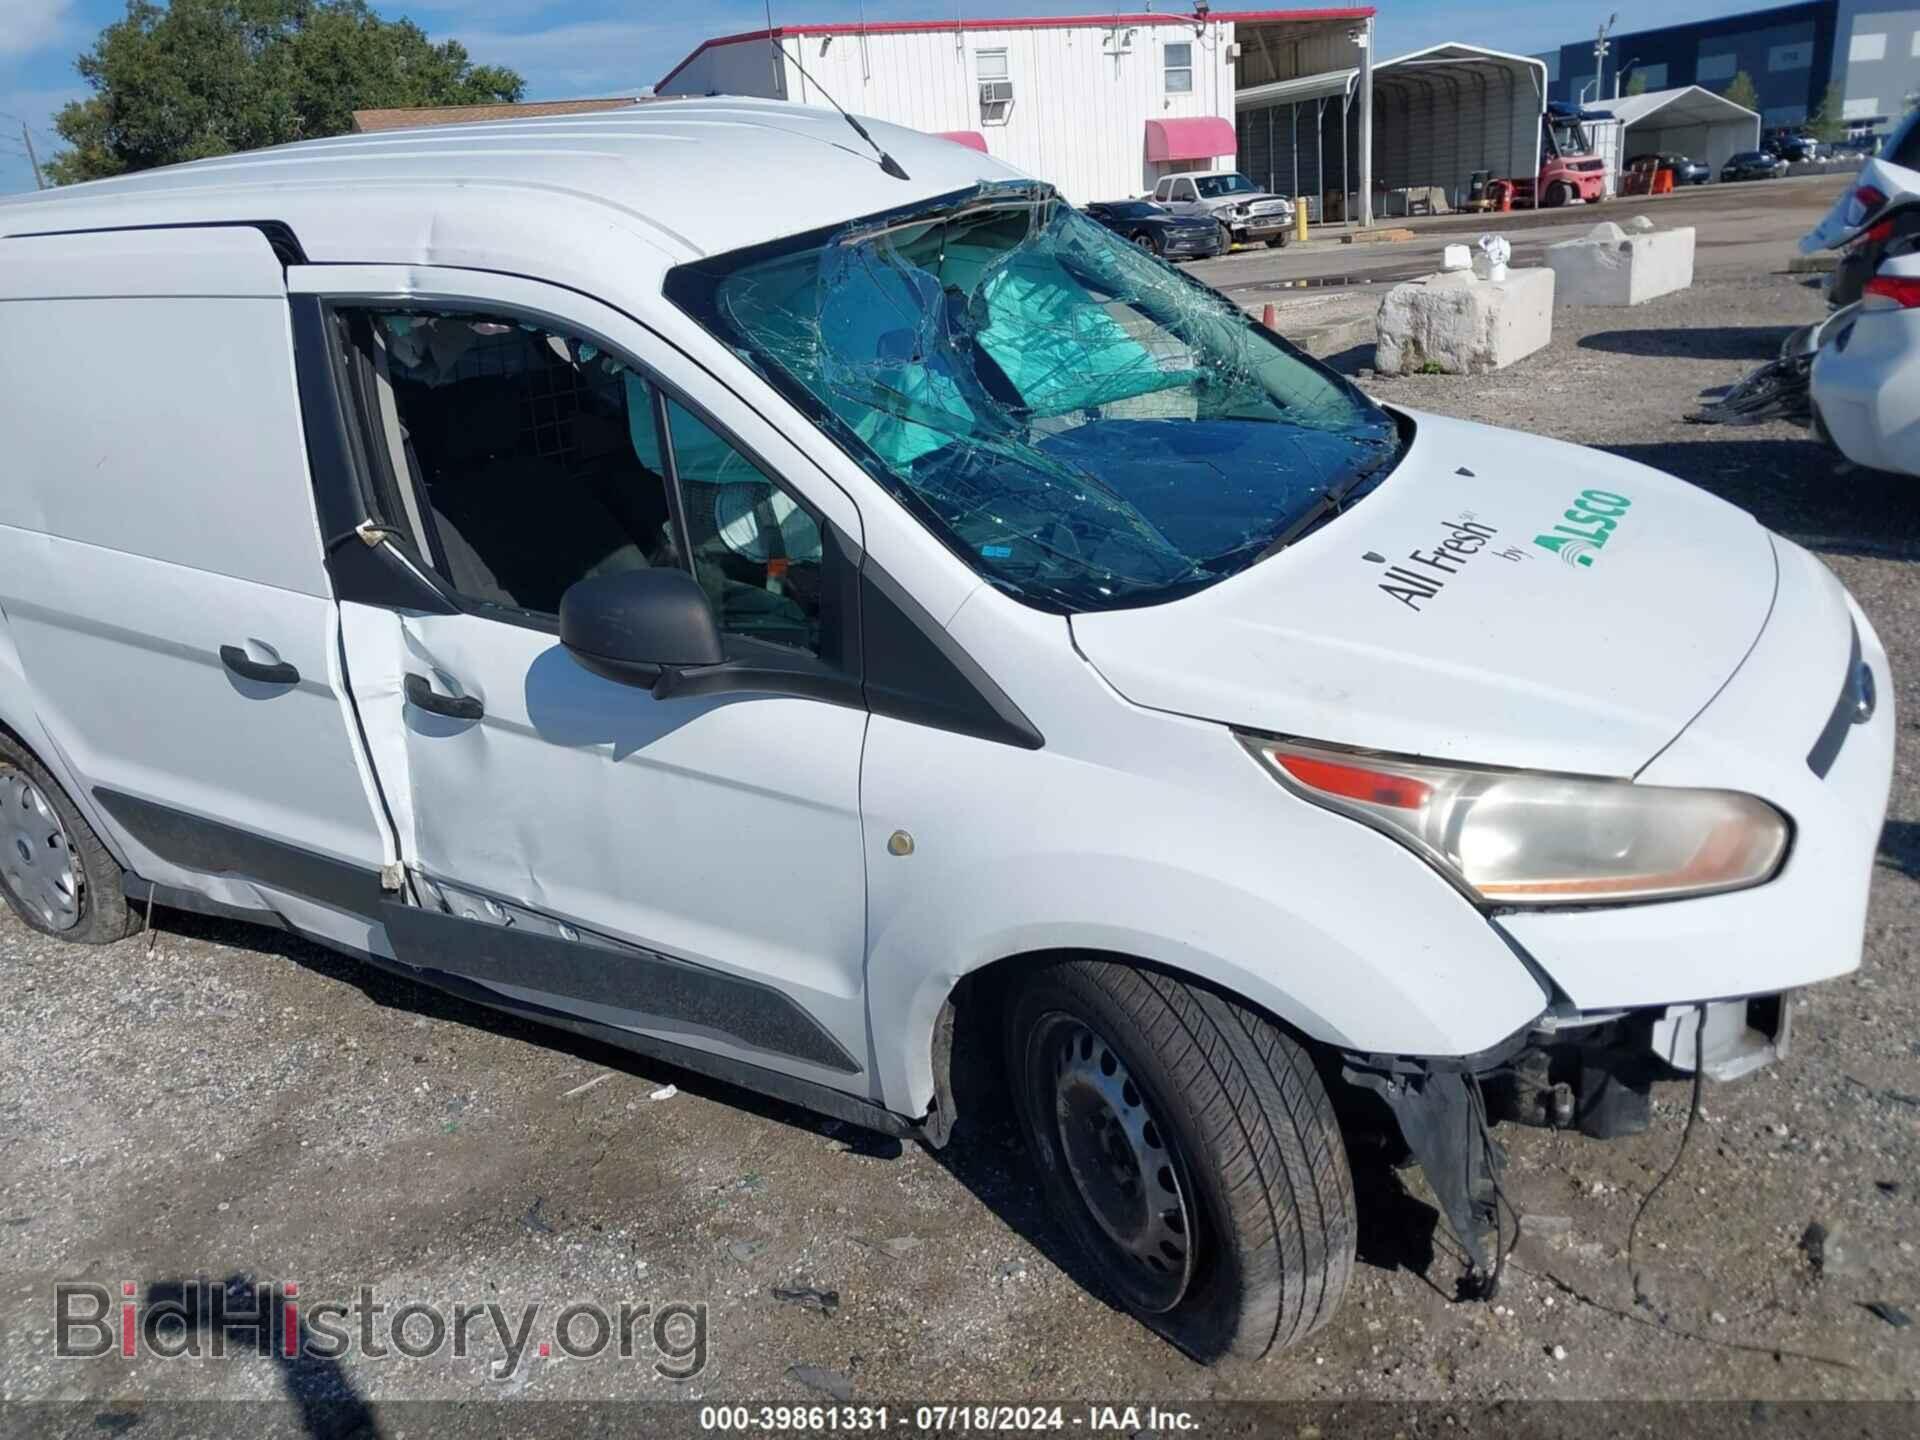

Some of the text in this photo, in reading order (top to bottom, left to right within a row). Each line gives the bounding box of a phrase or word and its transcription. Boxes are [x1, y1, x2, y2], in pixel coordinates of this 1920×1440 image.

[1377, 520, 1499, 612] All Fresh
[1491, 545, 1535, 562] by
[1532, 489, 1632, 568] ALSCO
